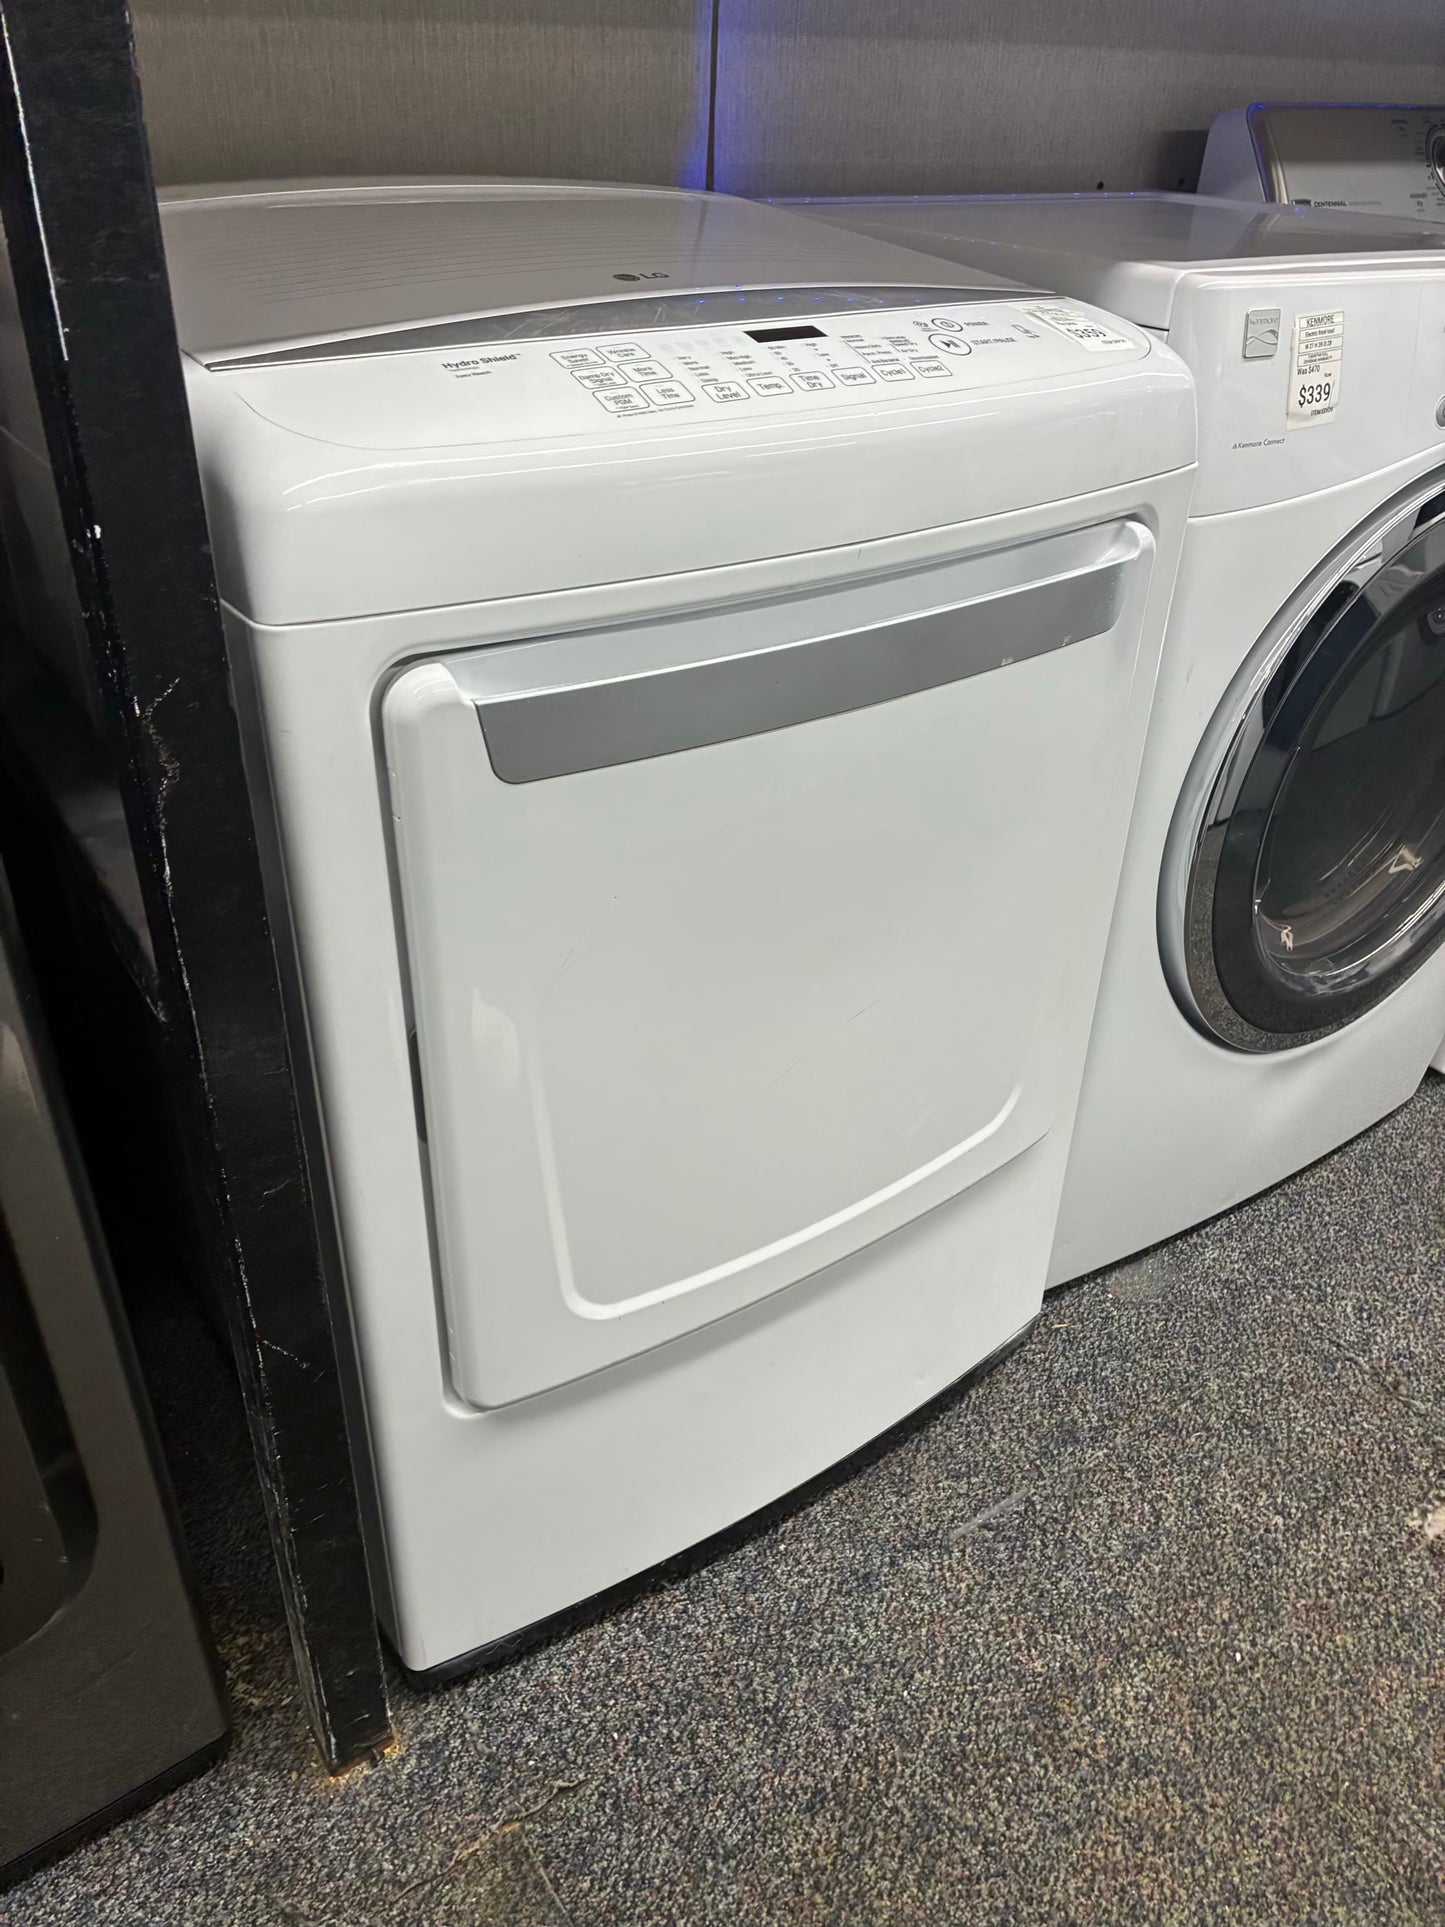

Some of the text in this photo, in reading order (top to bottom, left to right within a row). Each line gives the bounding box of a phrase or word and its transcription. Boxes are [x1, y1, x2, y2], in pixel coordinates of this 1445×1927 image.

[1306, 314, 1335, 328] KENMORE
[1066, 327, 1107, 340] $359
[1305, 330, 1318, 338] Electric
[606, 347, 637, 355] Wrinkle
[441, 360, 479, 369] Hydro
[880, 368, 906, 377] Cycle1
[918, 365, 944, 374] Cycle2
[1297, 364, 1321, 375] Was $470
[578, 371, 615, 382] Damp Dry
[800, 374, 821, 382] Time
[841, 372, 867, 381] Signal
[757, 382, 785, 391] Temp.
[807, 380, 823, 388] Dry
[714, 385, 731, 393] Dry
[603, 393, 634, 402] Custom
[716, 392, 742, 400] Level
[1298, 382, 1331, 408] $339
[1238, 438, 1285, 449] Kenmore Connect
